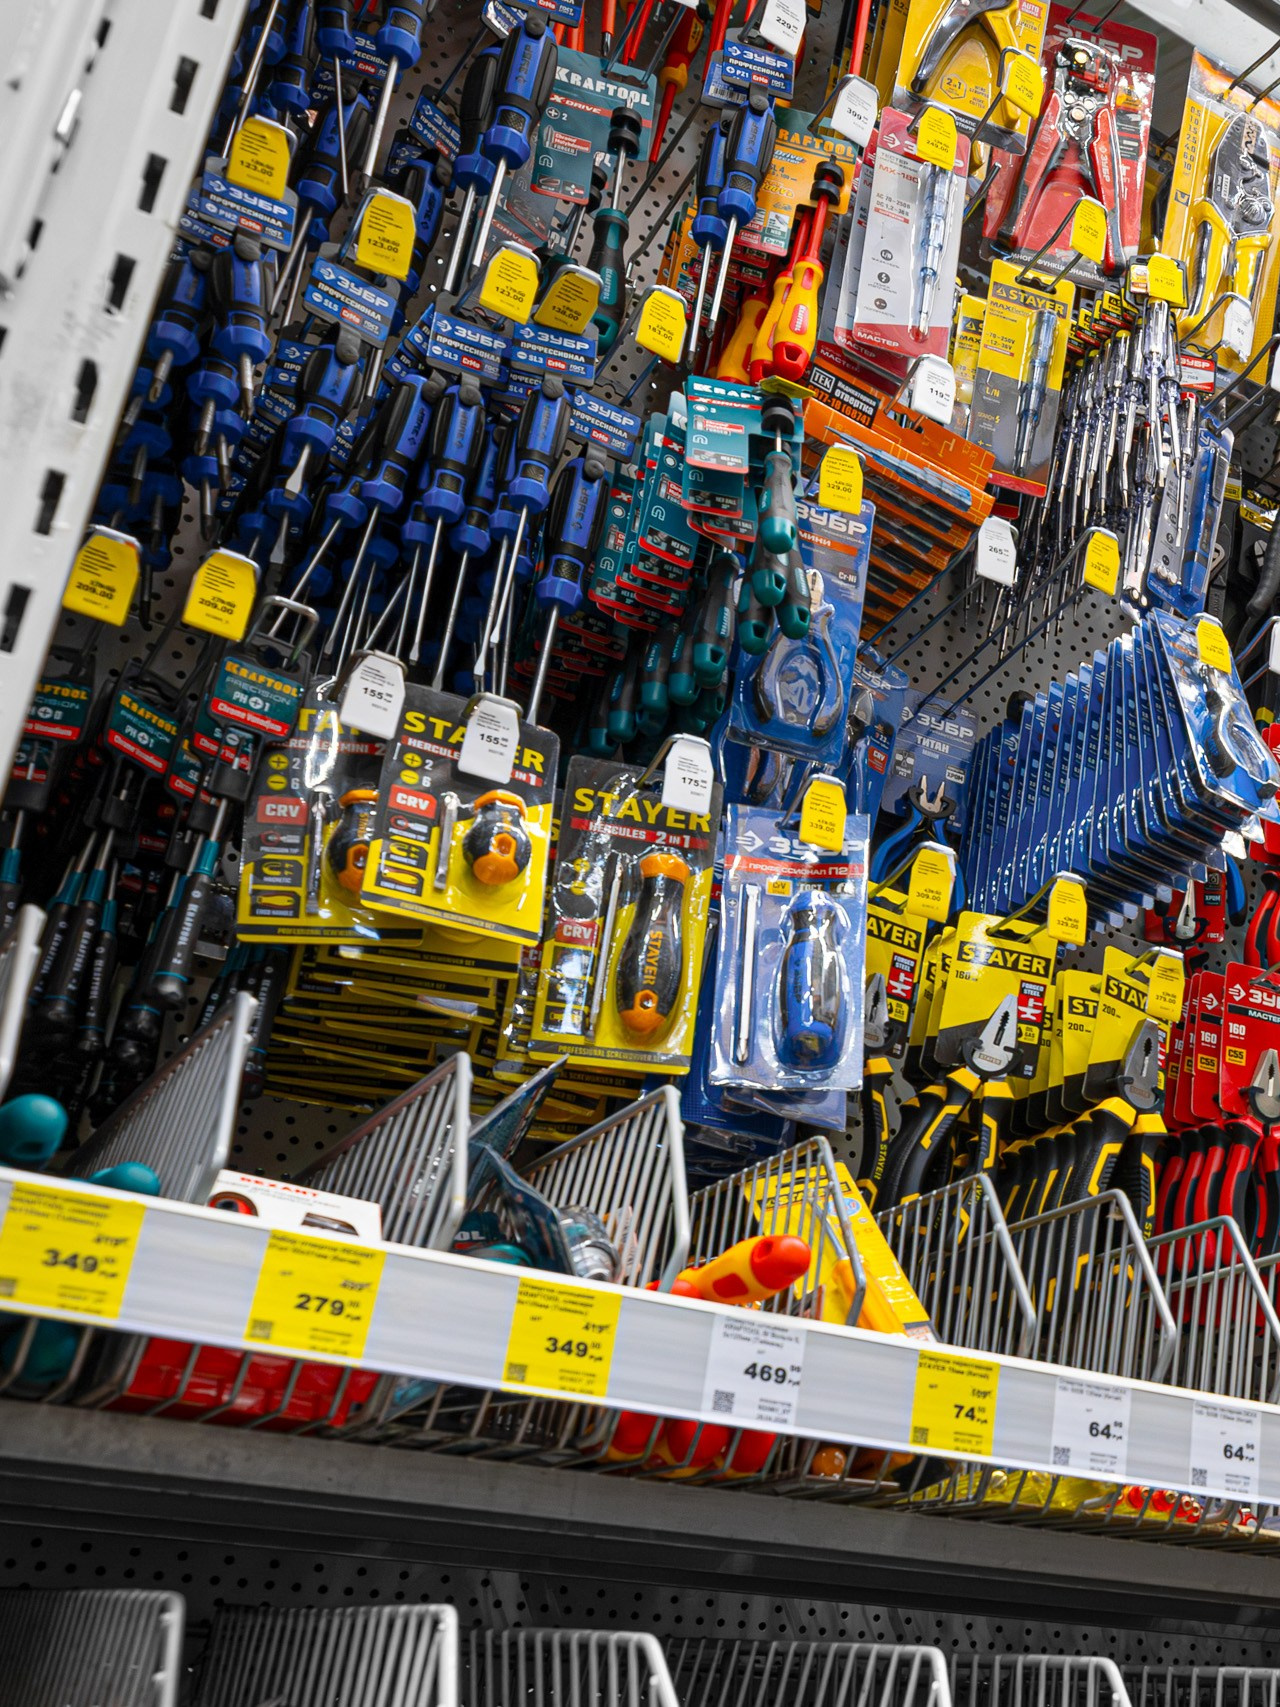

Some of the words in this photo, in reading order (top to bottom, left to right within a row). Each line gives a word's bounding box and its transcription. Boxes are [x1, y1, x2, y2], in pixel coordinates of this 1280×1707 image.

[741, 47, 789, 69] ЗУБР
[729, 57, 785, 78] ПРОФЕССИОНАЛ
[555, 66, 650, 106] KRAFTOOL
[562, 111, 567, 120] 2
[846, 107, 862, 121] 399
[777, 128, 854, 158] RAFTOOL
[239, 160, 273, 177] 123.00
[229, 186, 288, 216] ЗУБР
[210, 193, 283, 228] ПРОФЕССИОНАЛ
[367, 237, 399, 253] 123.00
[336, 275, 389, 307] ЗУБР
[494, 286, 524, 303] 123.00
[318, 282, 382, 321] ПРОФЕССИОНАЛ
[1005, 288, 1065, 318] STAYER
[551, 306, 579, 322] 138.00
[454, 325, 507, 349] ЗУБР
[539, 329, 589, 351] ЗУБР
[647, 324, 674, 342] 183.00
[857, 330, 900, 347] МАСТЕР
[436, 336, 501, 363] ПРОФЕССИОНАЛ
[520, 340, 586, 363] ПРОФЕССИОНАЛ
[837, 334, 876, 358] МАСТЕР
[1176, 356, 1211, 369] ЗУБР
[694, 383, 762, 400] KRAFT
[929, 387, 943, 398] 119
[587, 398, 634, 427] ЗУБР
[826, 482, 852, 493] 329.00
[796, 507, 867, 536] ЗУБР
[988, 545, 1004, 556] 265
[76, 581, 114, 601] 209.00
[199, 597, 234, 615] 209.00
[225, 662, 299, 697] KRAFTOOL
[225, 676, 292, 705] PRECISION
[363, 687, 382, 702] 155
[120, 695, 177, 734] KRAFTOOL
[120, 710, 171, 741] PRECISION
[914, 713, 974, 739] ЗУБР
[404, 712, 545, 772] STAER
[408, 736, 462, 759] HERCULE
[479, 733, 500, 745] 155
[917, 735, 949, 754] ТИТАН
[425, 759, 432, 770] 2
[422, 775, 431, 786] 6
[681, 776, 700, 786] 175
[397, 793, 428, 808] CRV
[265, 804, 298, 817] CRV
[574, 788, 711, 832] STAYER
[590, 823, 645, 839] HERCULES
[656, 832, 667, 844] 2
[809, 822, 835, 833] 339.00
[748, 862, 825, 876] ПРОФЕССИОНАЛ
[916, 894, 942, 903] 309.00
[1056, 919, 1079, 930] 329.00
[563, 927, 592, 940] CRV
[866, 918, 917, 949] AYER
[644, 930, 663, 985] STAYER
[962, 944, 1046, 976] STAYER
[955, 970, 971, 980] 160
[1022, 981, 1045, 991] FORGED
[1024, 989, 1042, 997] STEEL
[1108, 981, 1147, 1007] STAY
[1102, 1005, 1116, 1015] 200
[1068, 1022, 1083, 1031] 200
[1228, 1023, 1245, 1035] 160
[1229, 1022, 1245, 1035] 160
[1201, 1031, 1217, 1044] 160
[1200, 1058, 1216, 1068] C55
[1227, 1049, 1244, 1060] C55
[1228, 1051, 1245, 1060] C55
[42, 1249, 99, 1273] 349
[295, 1293, 345, 1315] 279
[546, 1337, 588, 1357] 349
[744, 1362, 786, 1384] 469
[955, 1405, 976, 1422] 74
[1089, 1422, 1111, 1439] 64
[1224, 1445, 1244, 1460] 64
